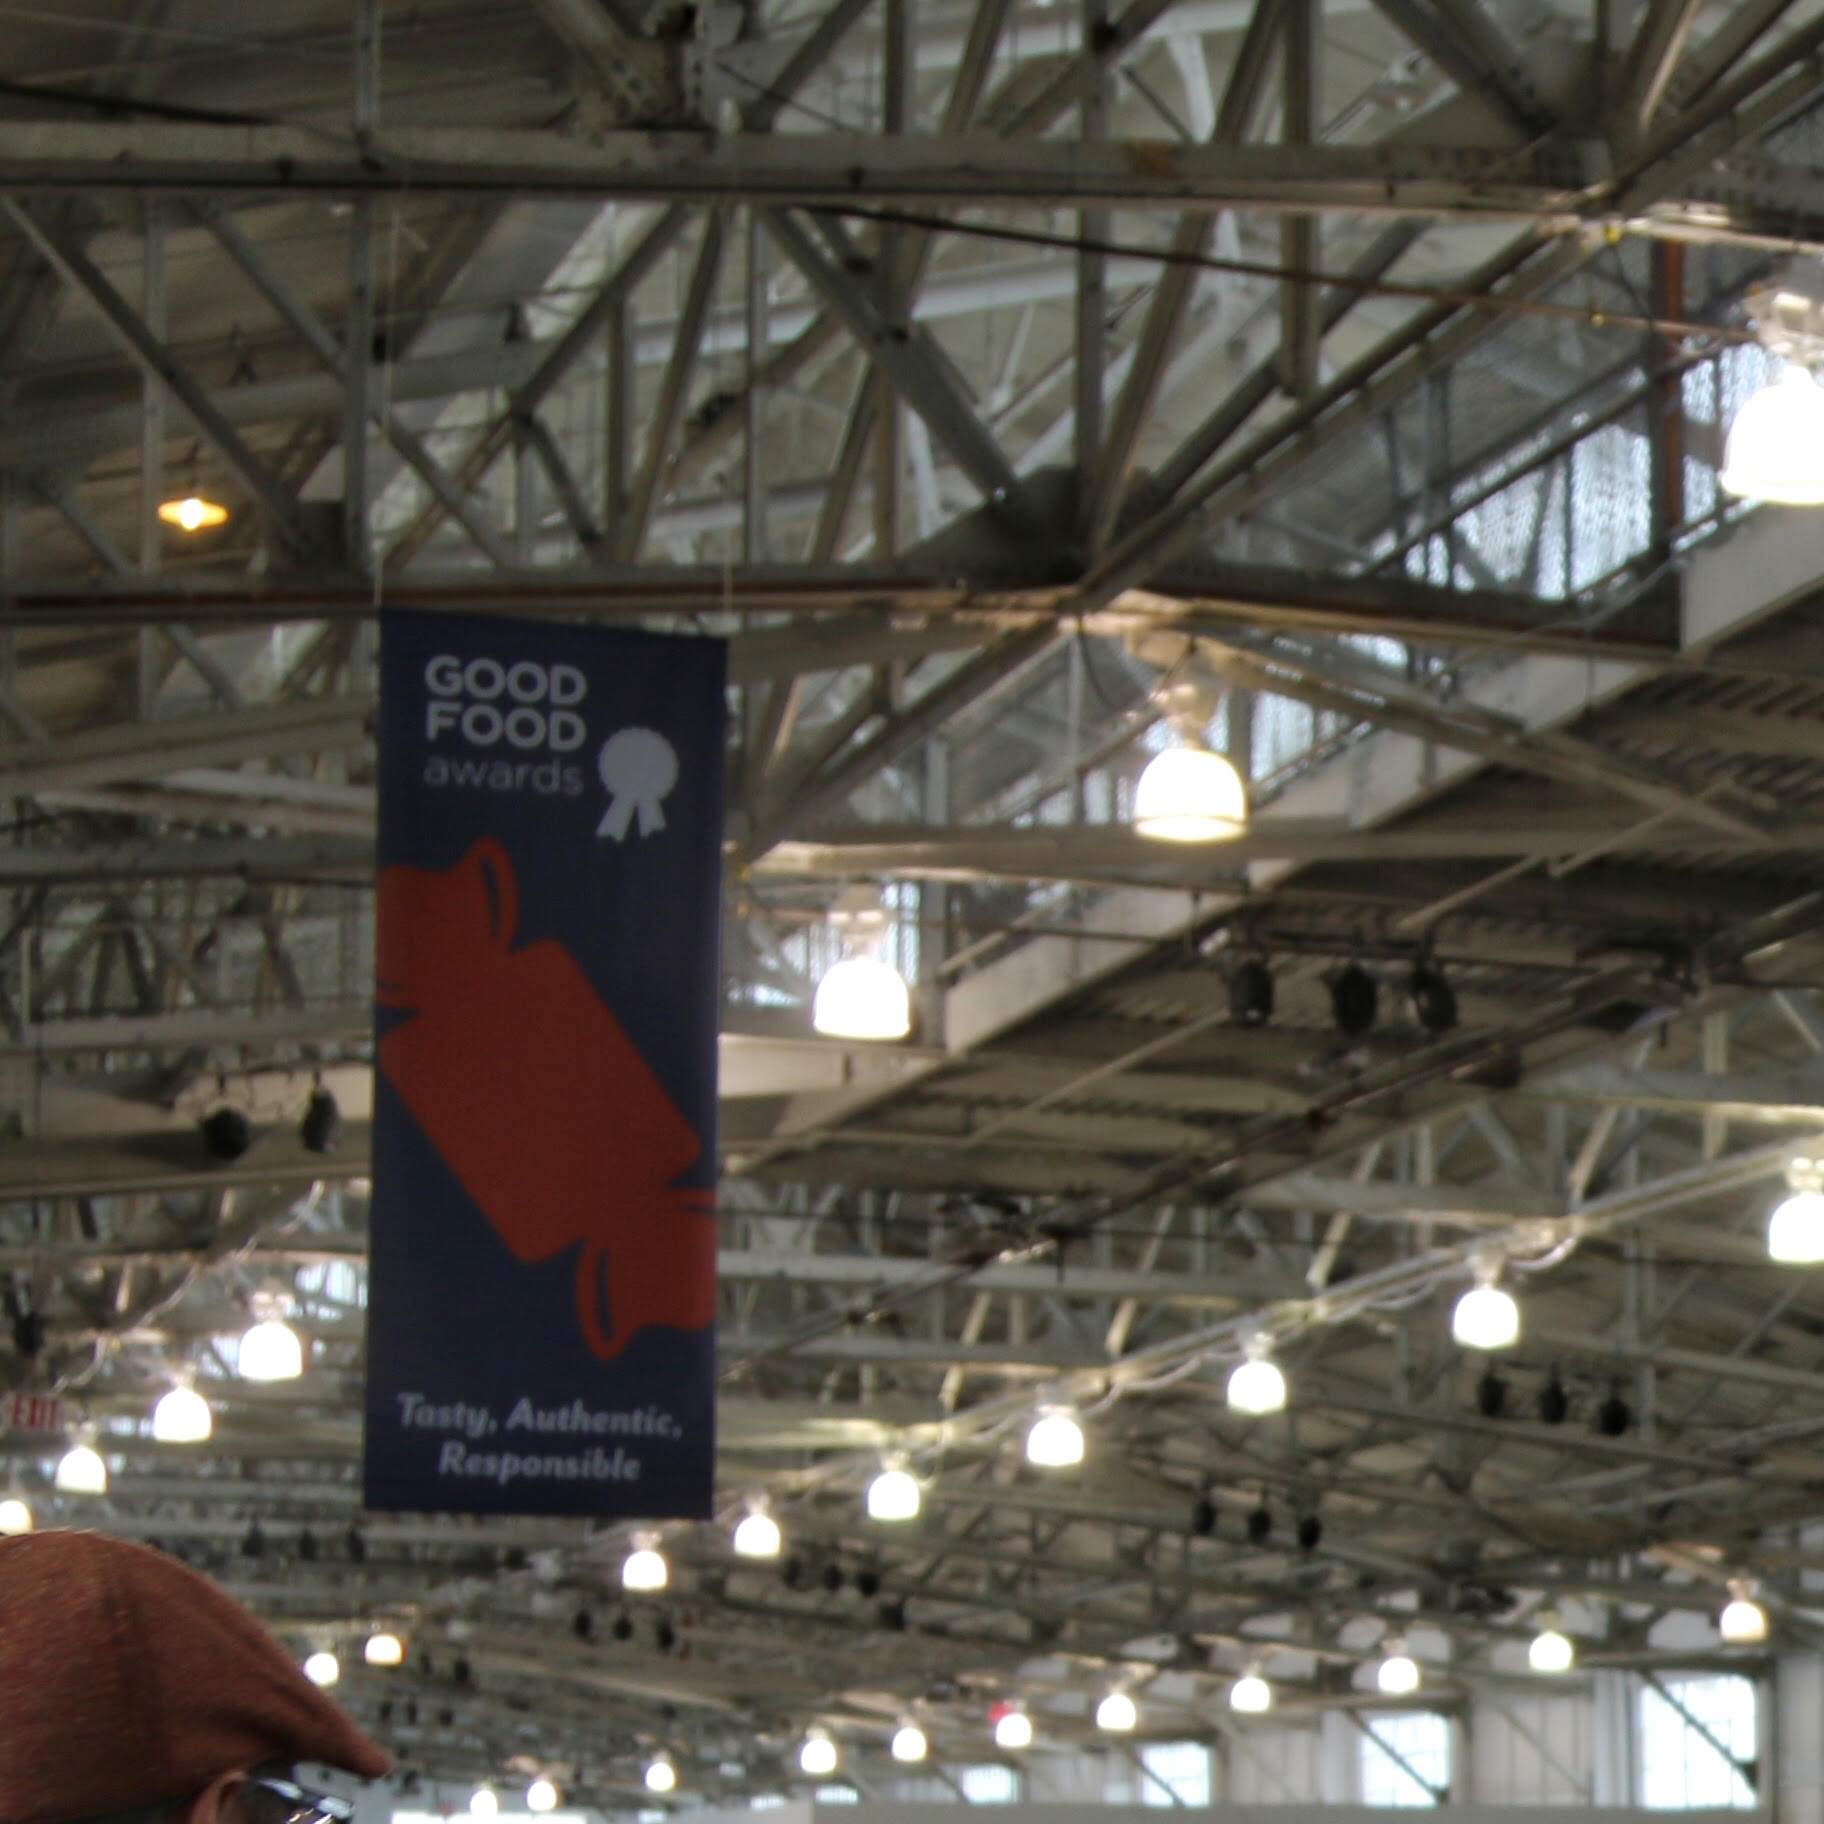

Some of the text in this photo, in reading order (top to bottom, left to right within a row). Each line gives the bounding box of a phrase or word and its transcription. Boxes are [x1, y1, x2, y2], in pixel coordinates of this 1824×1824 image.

[424, 655, 587, 704] GOOD
[426, 702, 587, 750] FOOD
[424, 757, 583, 796] awards
[399, 1393, 683, 1441] Tasty, Authentic,
[439, 1442, 641, 1484] Responsible
